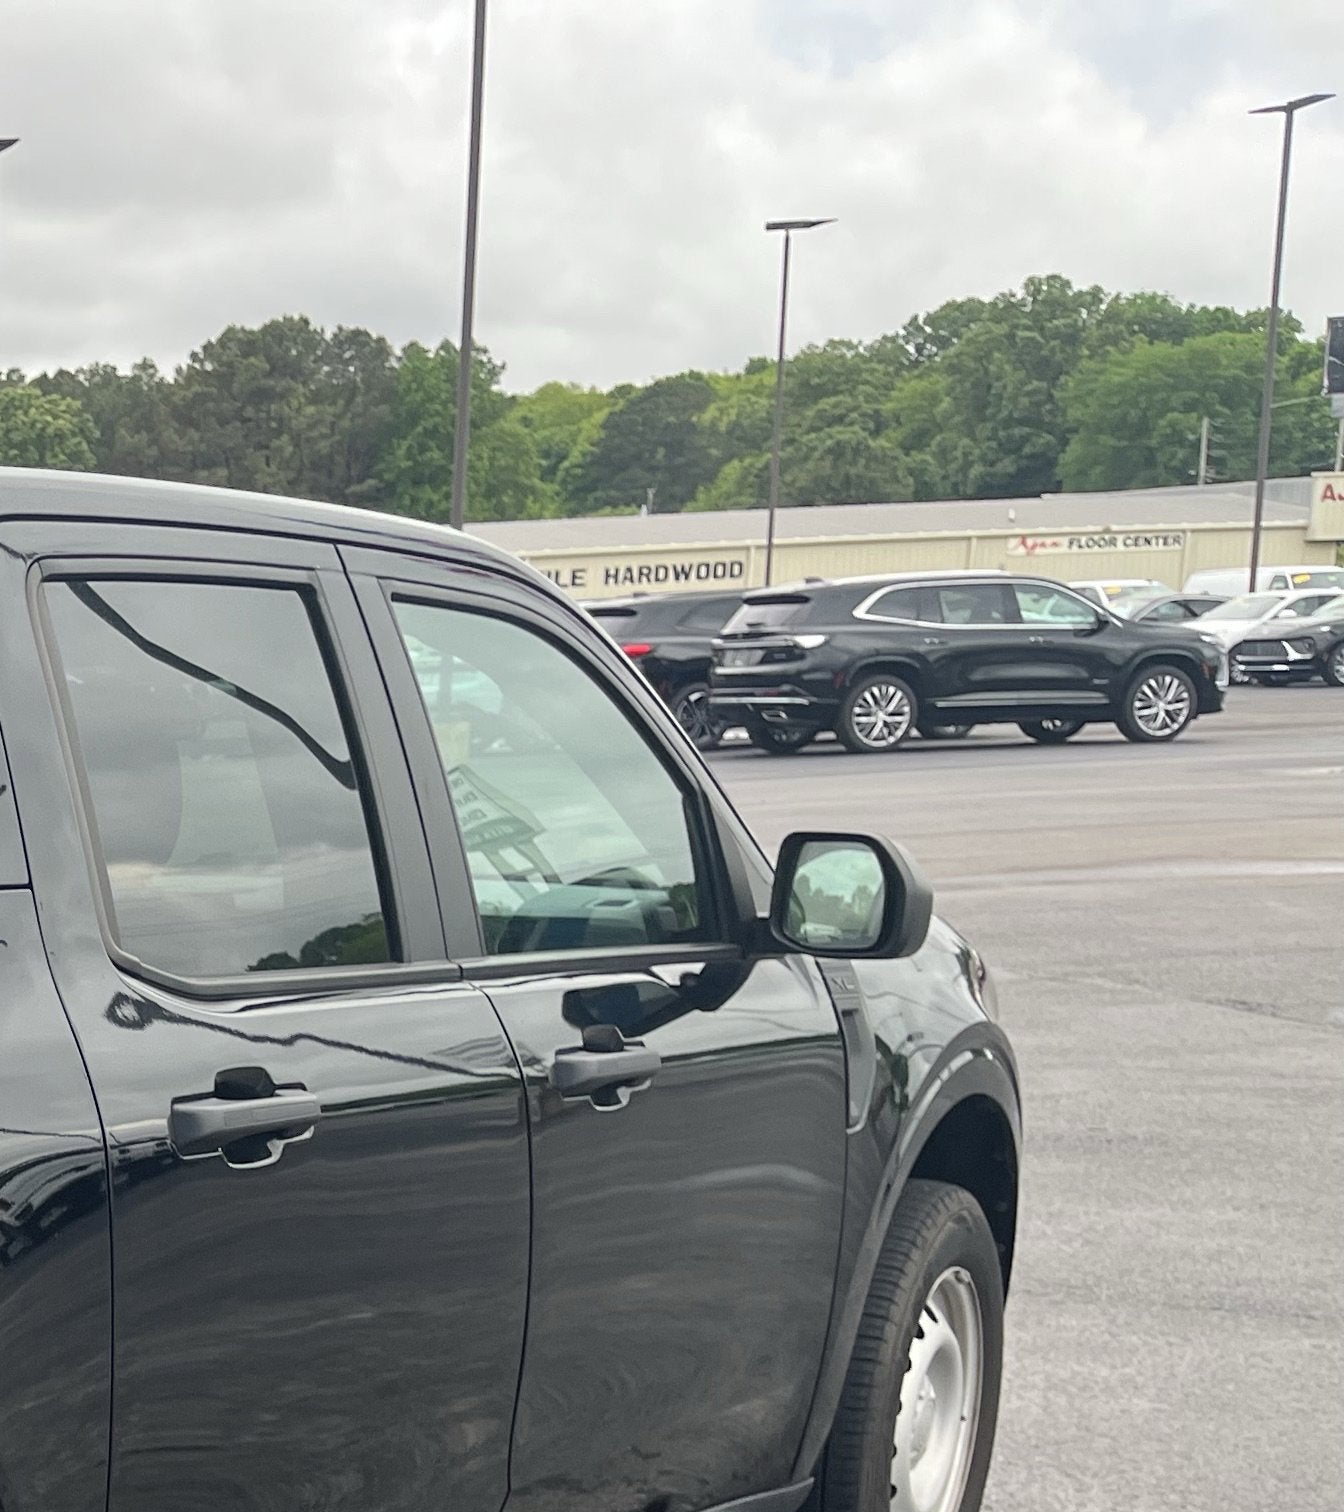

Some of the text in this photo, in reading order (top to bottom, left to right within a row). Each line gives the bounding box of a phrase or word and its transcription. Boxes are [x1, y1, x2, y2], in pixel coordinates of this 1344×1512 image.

[1068, 536, 1117, 550] FLOOR
[1123, 534, 1185, 548] CENTER
[604, 560, 745, 587] HARDWOOD
